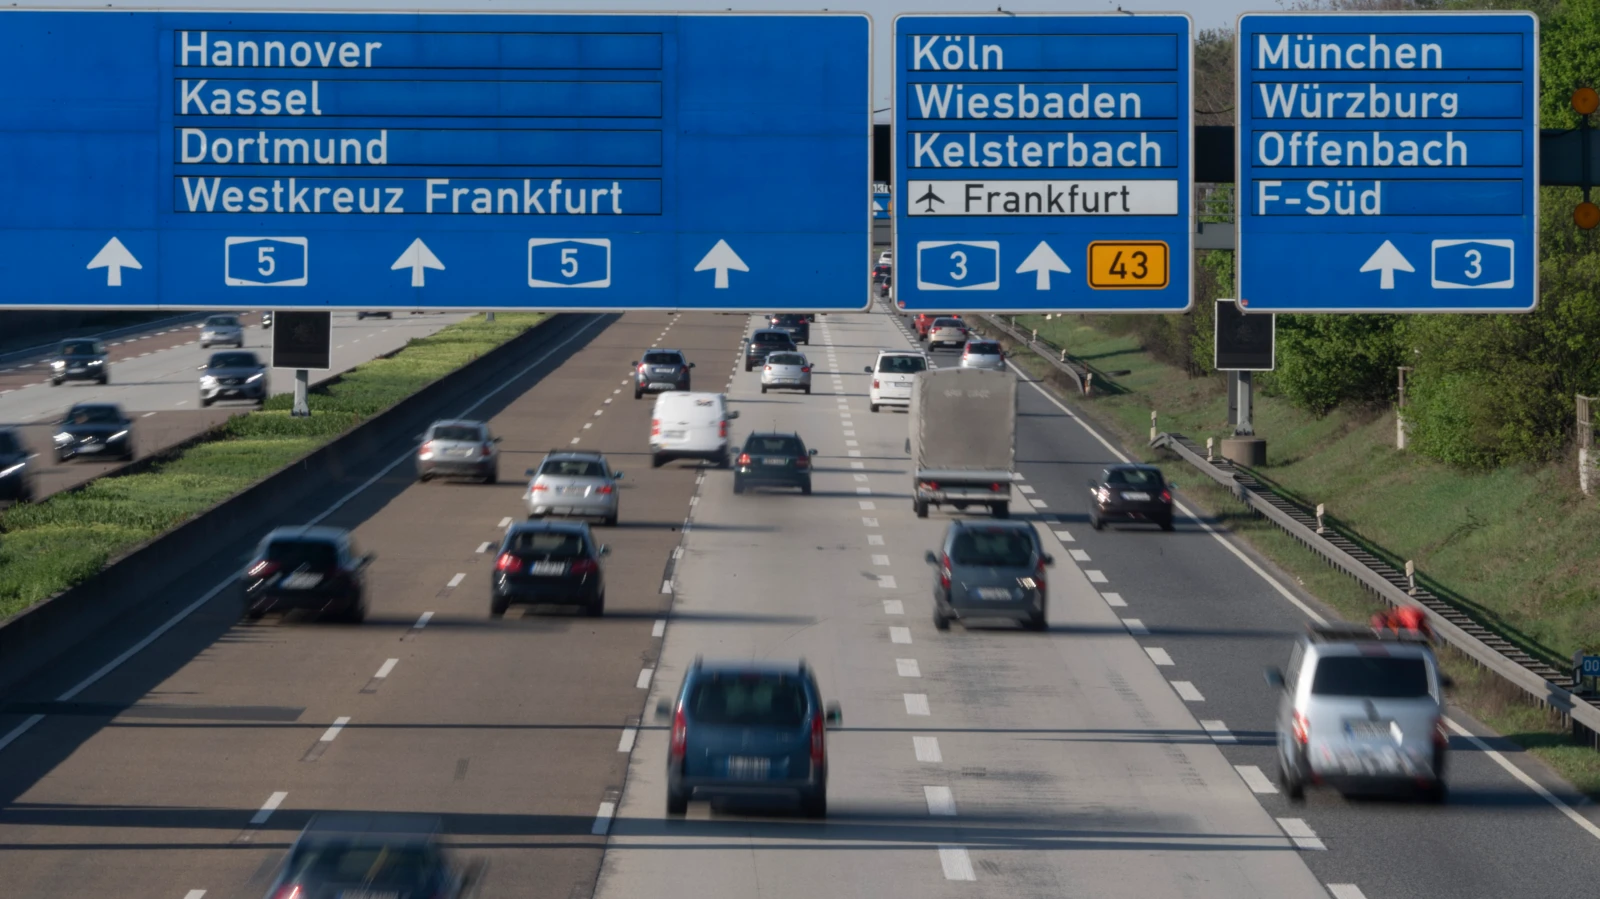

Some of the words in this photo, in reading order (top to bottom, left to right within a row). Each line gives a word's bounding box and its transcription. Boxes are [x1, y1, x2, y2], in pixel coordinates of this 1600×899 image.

[182, 31, 382, 67] Hannover
[913, 35, 1004, 70] Köln
[1259, 35, 1442, 69] München
[182, 80, 321, 115] Kassel
[915, 84, 1142, 119] Wiesbaden
[1260, 83, 1459, 118] Würzburg
[182, 128, 386, 164] Dortmund
[914, 132, 1162, 168] Kelsterbach
[1259, 132, 1467, 166] Offenbach
[183, 178, 404, 213] Westkreuz
[426, 179, 623, 214] Frankfurt
[964, 183, 1130, 213] Frankfurt
[1259, 180, 1381, 215] F-Süd
[257, 247, 276, 277] 5
[560, 248, 579, 278] 5
[950, 251, 968, 281] 3
[1109, 251, 1149, 279] 43
[1464, 250, 1483, 280] 3
